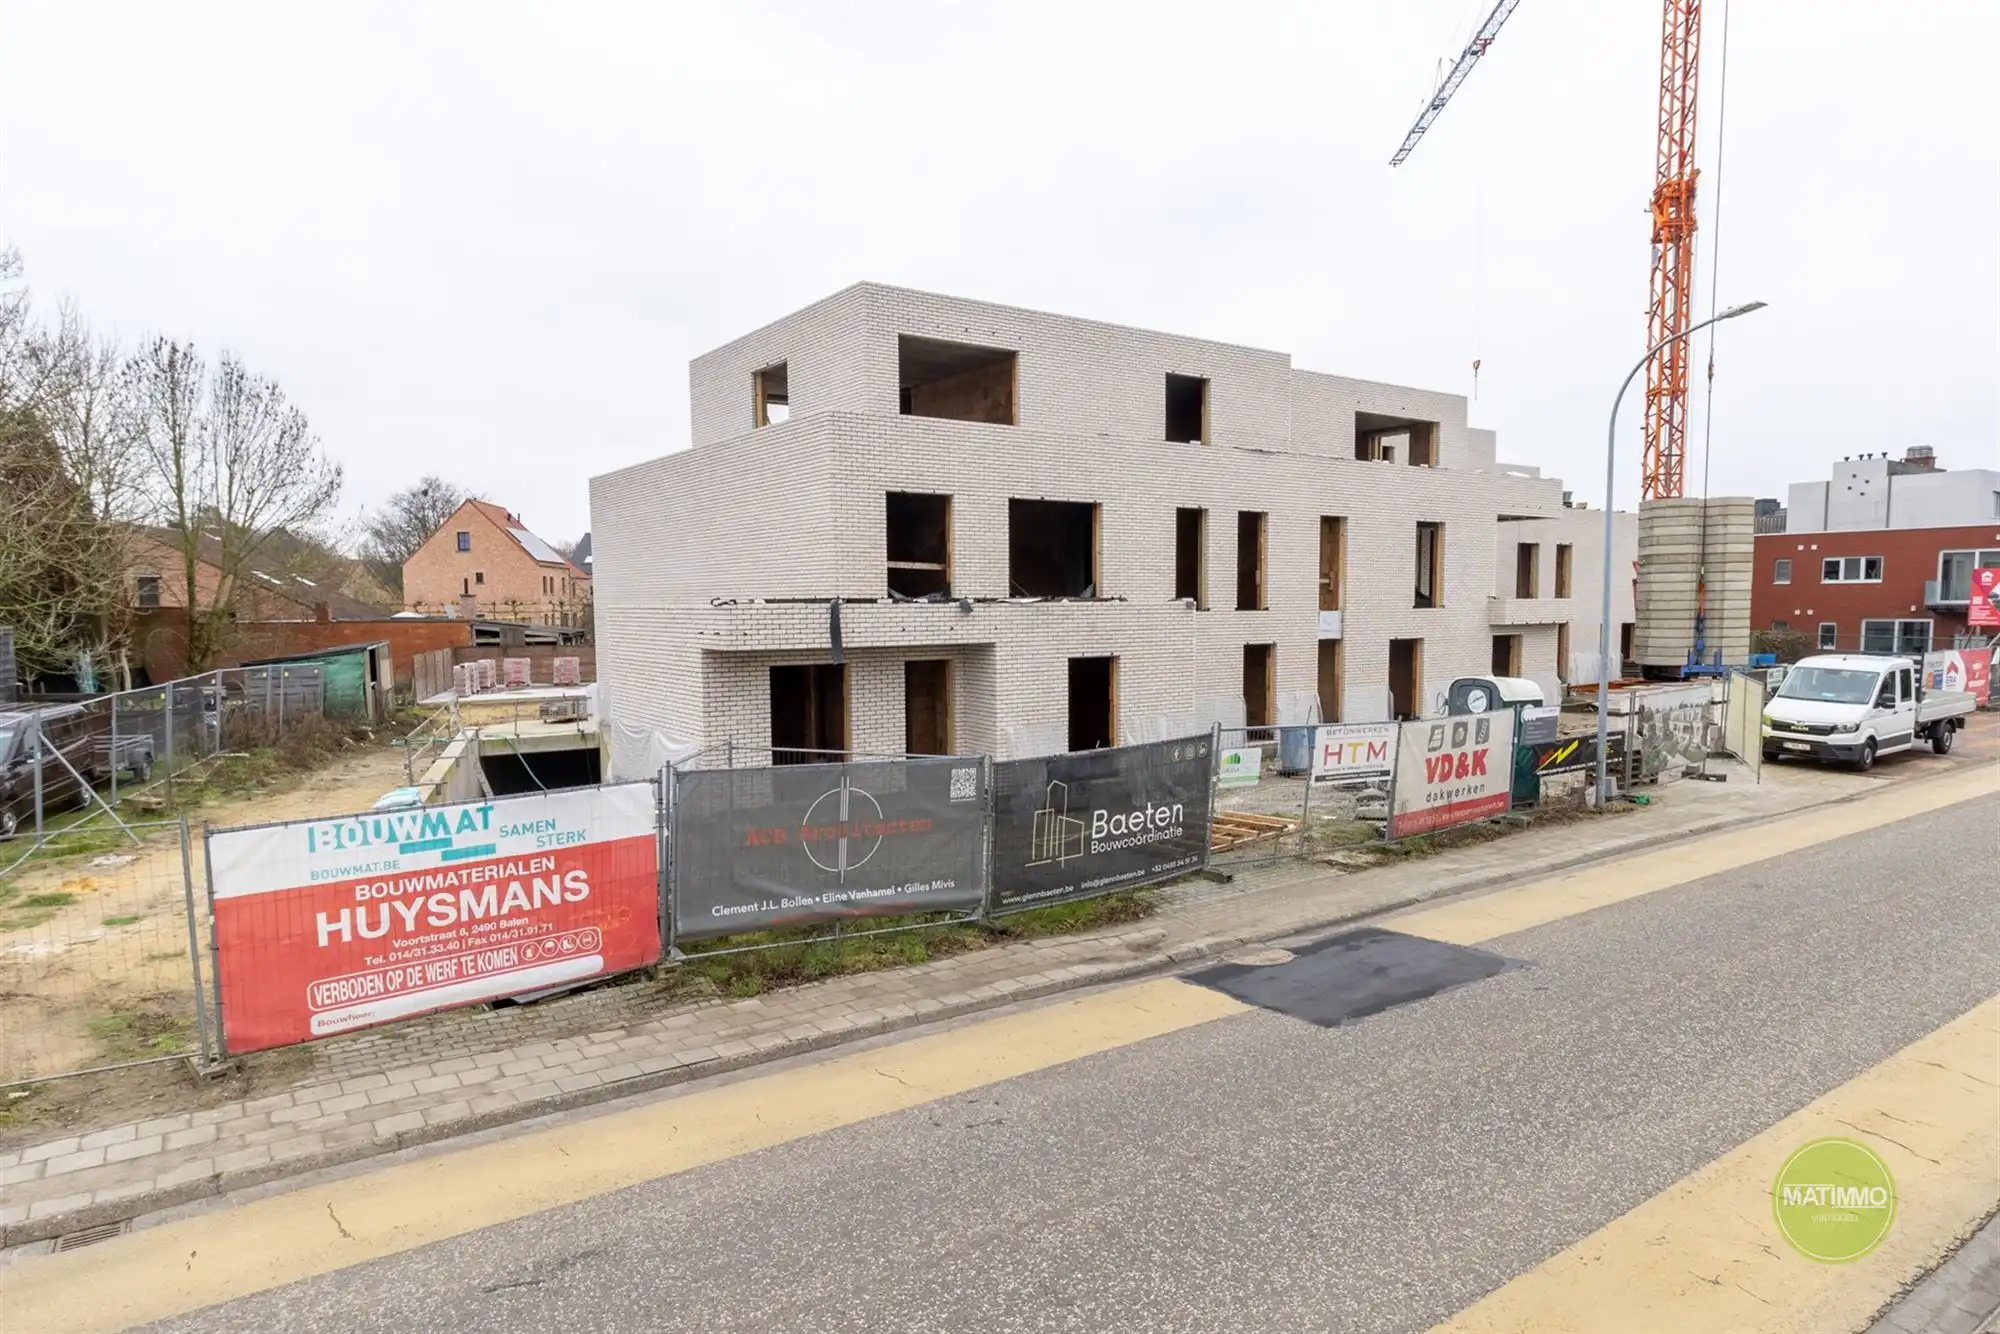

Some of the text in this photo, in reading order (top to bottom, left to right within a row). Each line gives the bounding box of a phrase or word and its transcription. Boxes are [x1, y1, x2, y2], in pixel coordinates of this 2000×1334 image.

[1326, 727, 1389, 736] BETONWERKEN
[1324, 740, 1388, 766] HTM
[1425, 747, 1489, 785] VD&K
[1426, 783, 1486, 803] dakwerken
[308, 804, 494, 853] BOUWMAT
[499, 818, 557, 838] SAMEN
[1092, 802, 1184, 839] Baeten
[536, 829, 587, 848] STERK
[1091, 826, 1184, 854] Bouwcoördinatie
[310, 859, 400, 881] BOUWMAT.BE
[355, 855, 555, 900] BOUWMATERIALEN
[316, 869, 590, 948] HUYSMANS
[711, 901, 759, 918] Clement
[760, 898, 780, 912] J.L.
[781, 895, 814, 909] Bollen
[822, 891, 848, 904] Eline
[848, 884, 896, 901] Vanhamel
[904, 881, 930, 894] Gilles
[931, 878, 956, 891] Mivis
[364, 955, 386, 966] Tel.
[389, 940, 460, 962] 014/31.33.40
[468, 937, 488, 947] Fax
[490, 923, 553, 943] 014/31.91.71
[392, 929, 458, 949] Voortstraat
[471, 922, 497, 935] 2490
[499, 916, 529, 928] Balen
[313, 946, 519, 1006] VERBODEN OP DE WERF TE KOMEN
